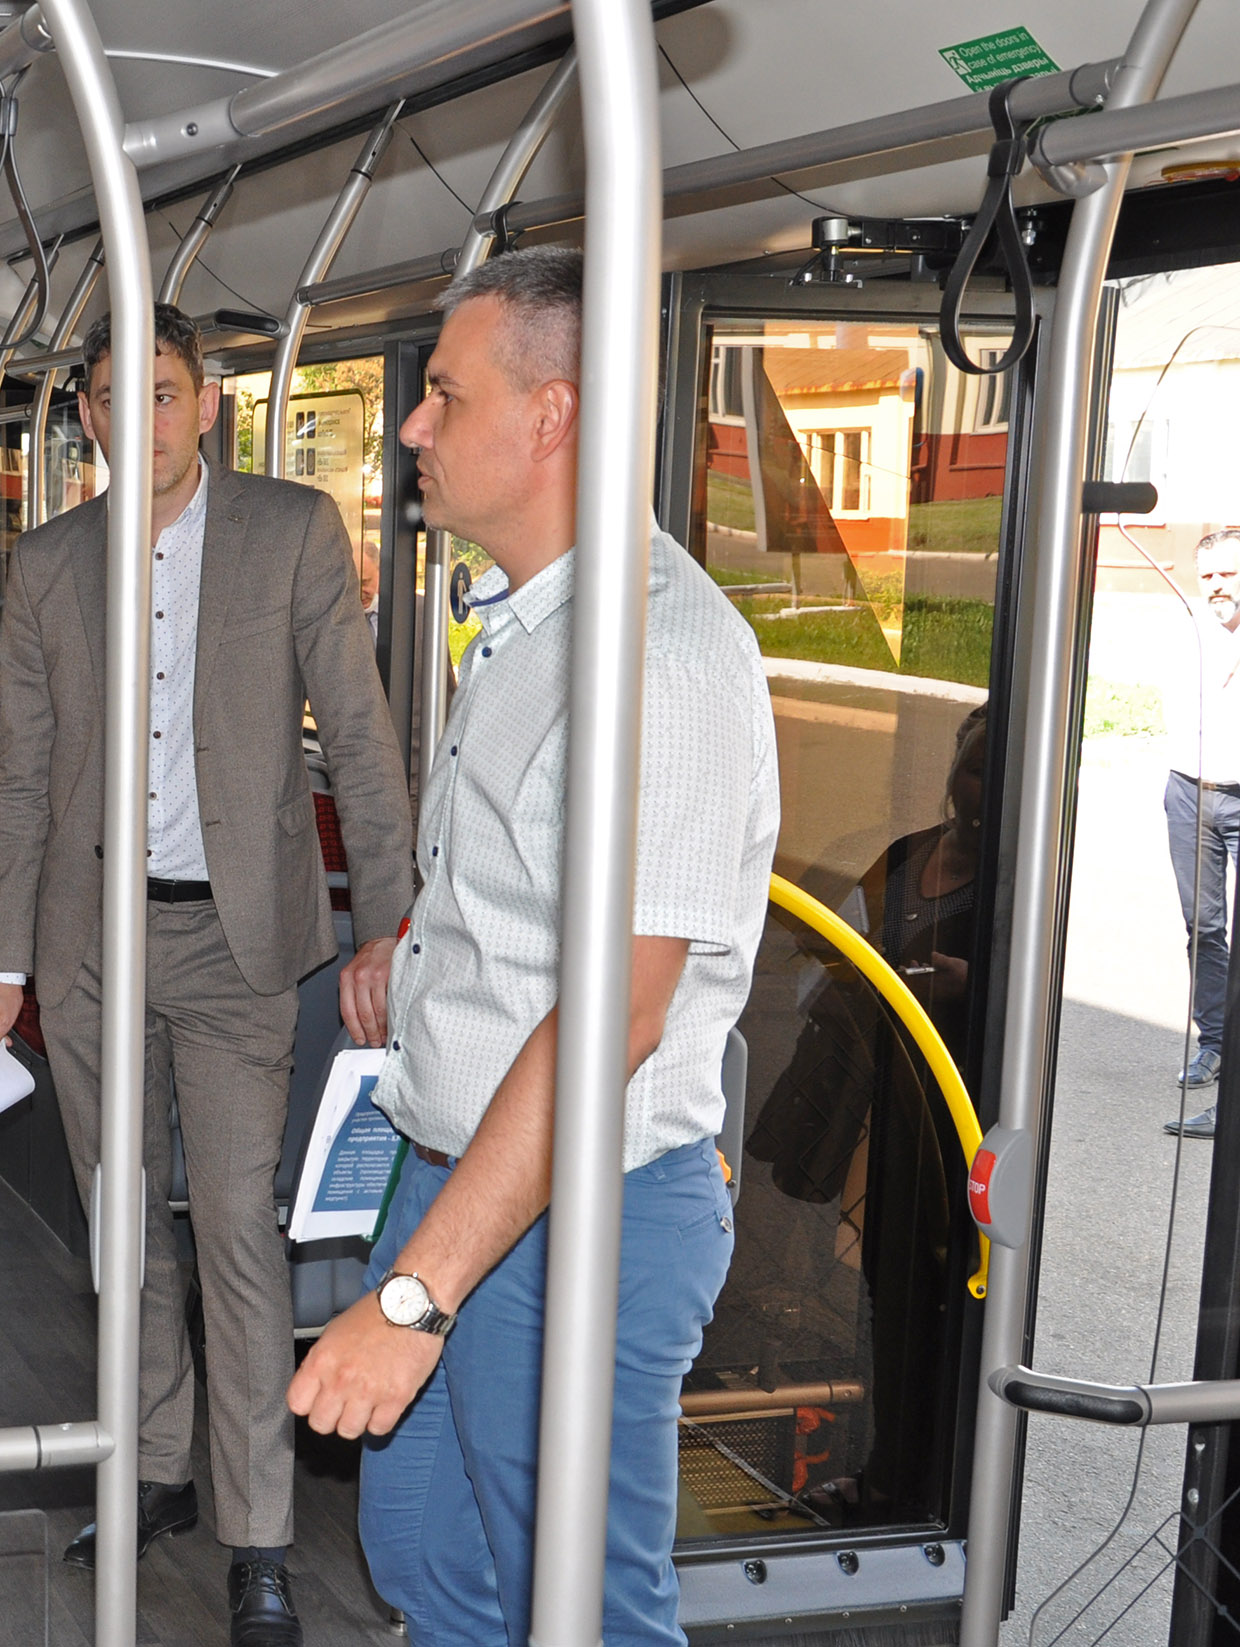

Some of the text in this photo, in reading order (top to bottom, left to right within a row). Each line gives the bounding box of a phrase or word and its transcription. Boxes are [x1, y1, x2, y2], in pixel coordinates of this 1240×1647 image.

[959, 32, 1029, 57] Open the doors in
[968, 44, 1041, 69] case of emergency
[1011, 57, 1048, 73] дзверы
[969, 1179, 986, 1195] STOP
